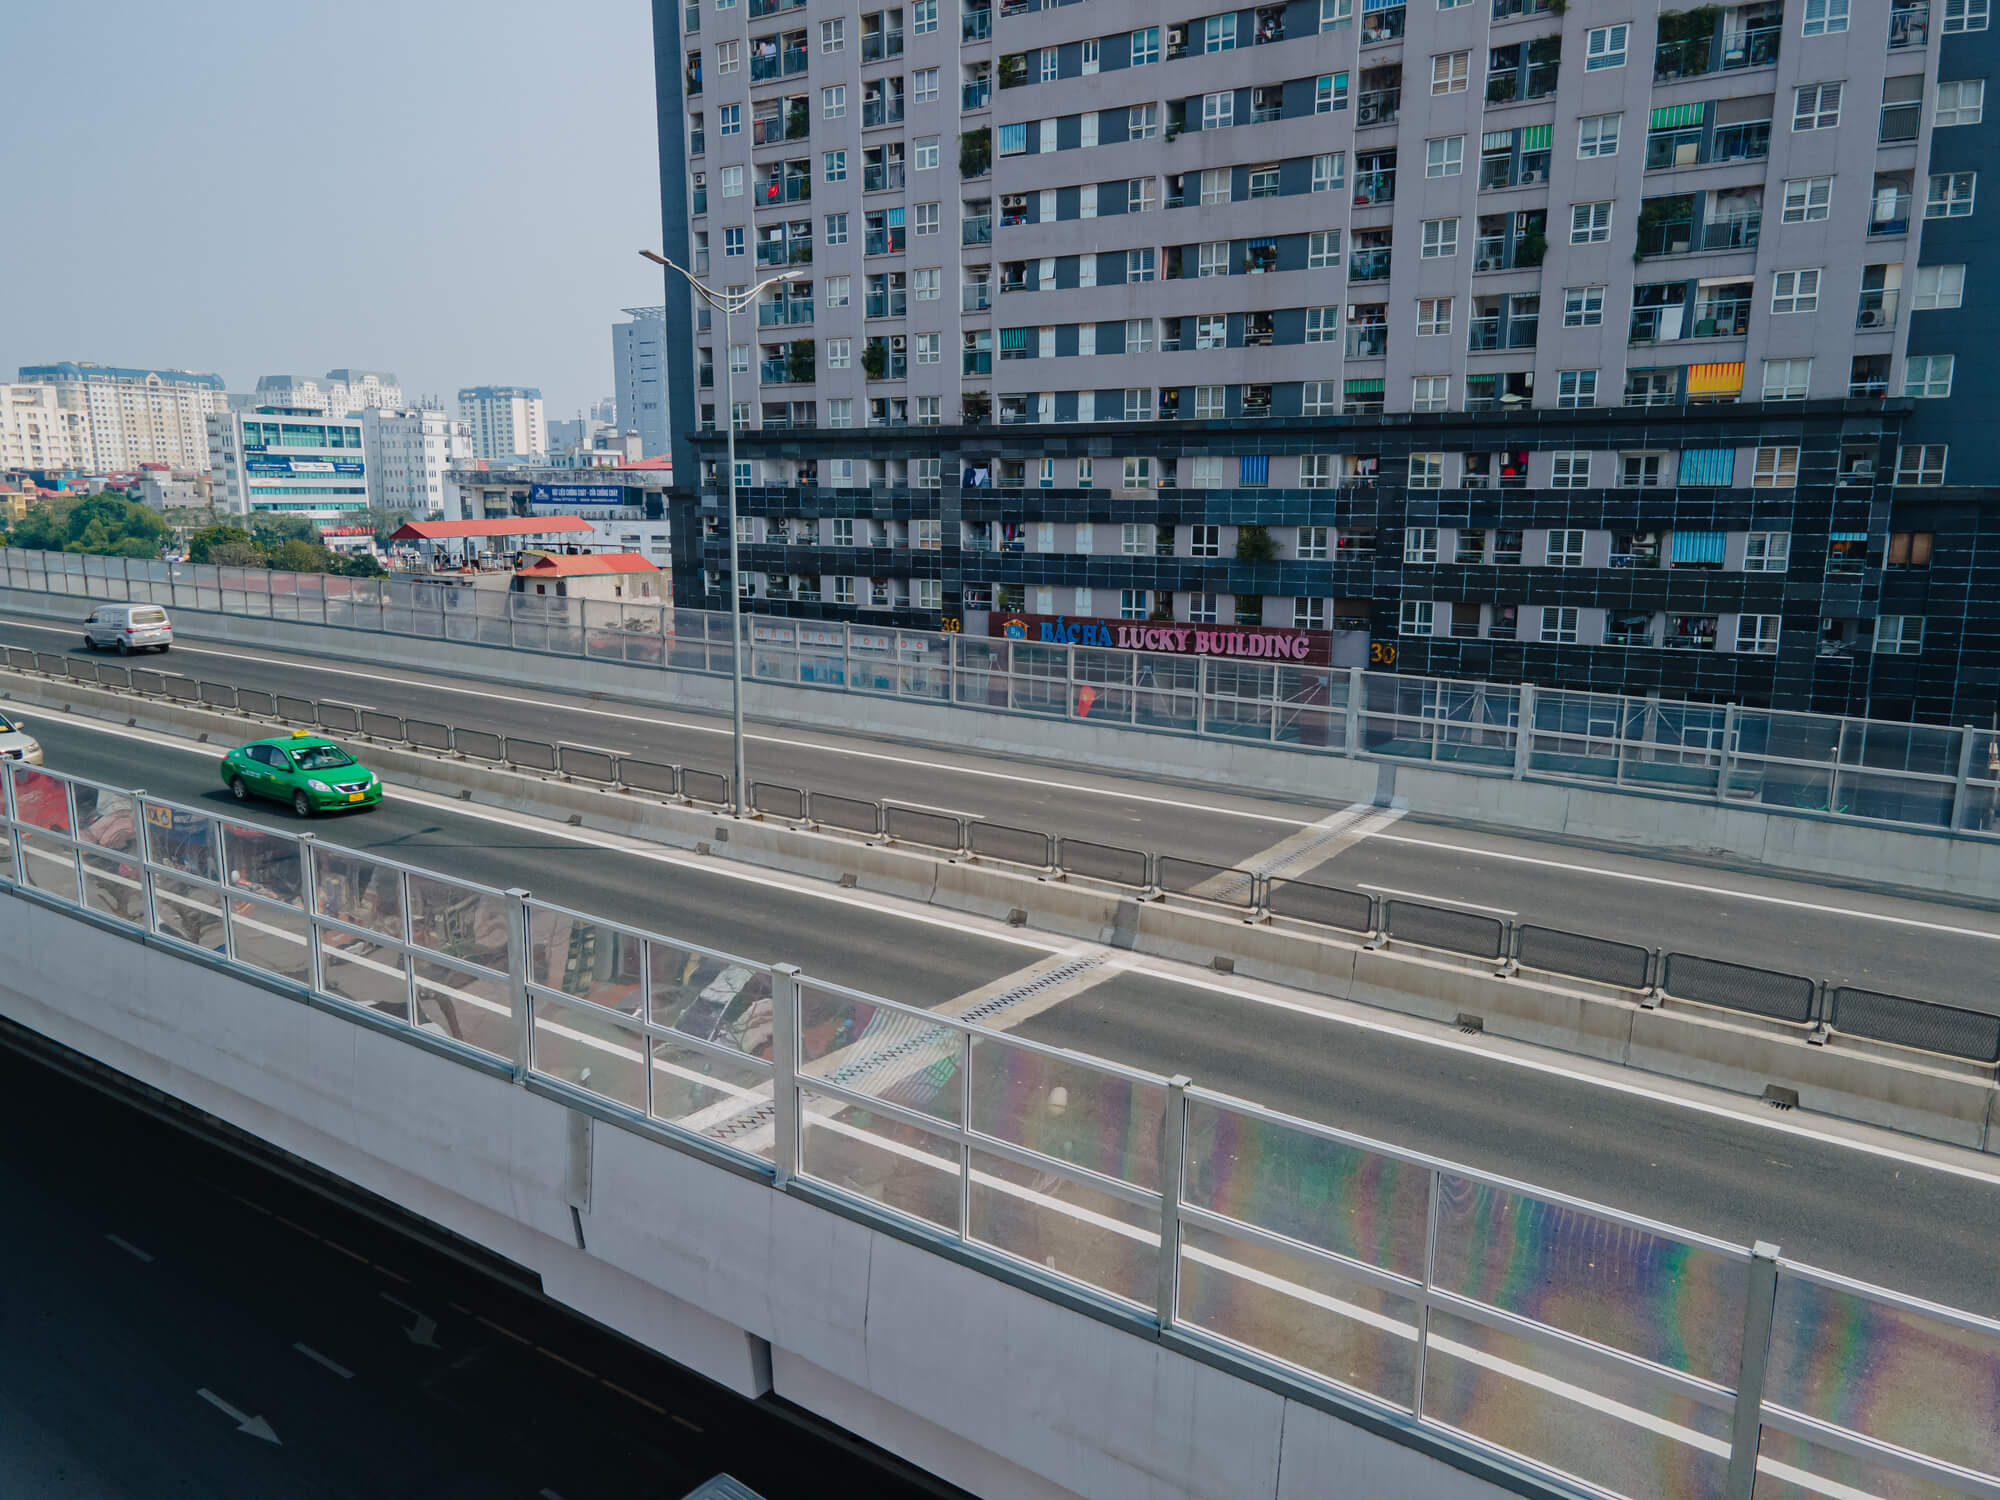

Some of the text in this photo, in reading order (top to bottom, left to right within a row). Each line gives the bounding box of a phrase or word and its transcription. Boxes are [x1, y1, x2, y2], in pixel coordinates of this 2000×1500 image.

[941, 617, 960, 633] 30
[1118, 626, 1191, 652] LUCKY
[1195, 631, 1310, 659] BUILDING
[1370, 643, 1395, 664] 30
